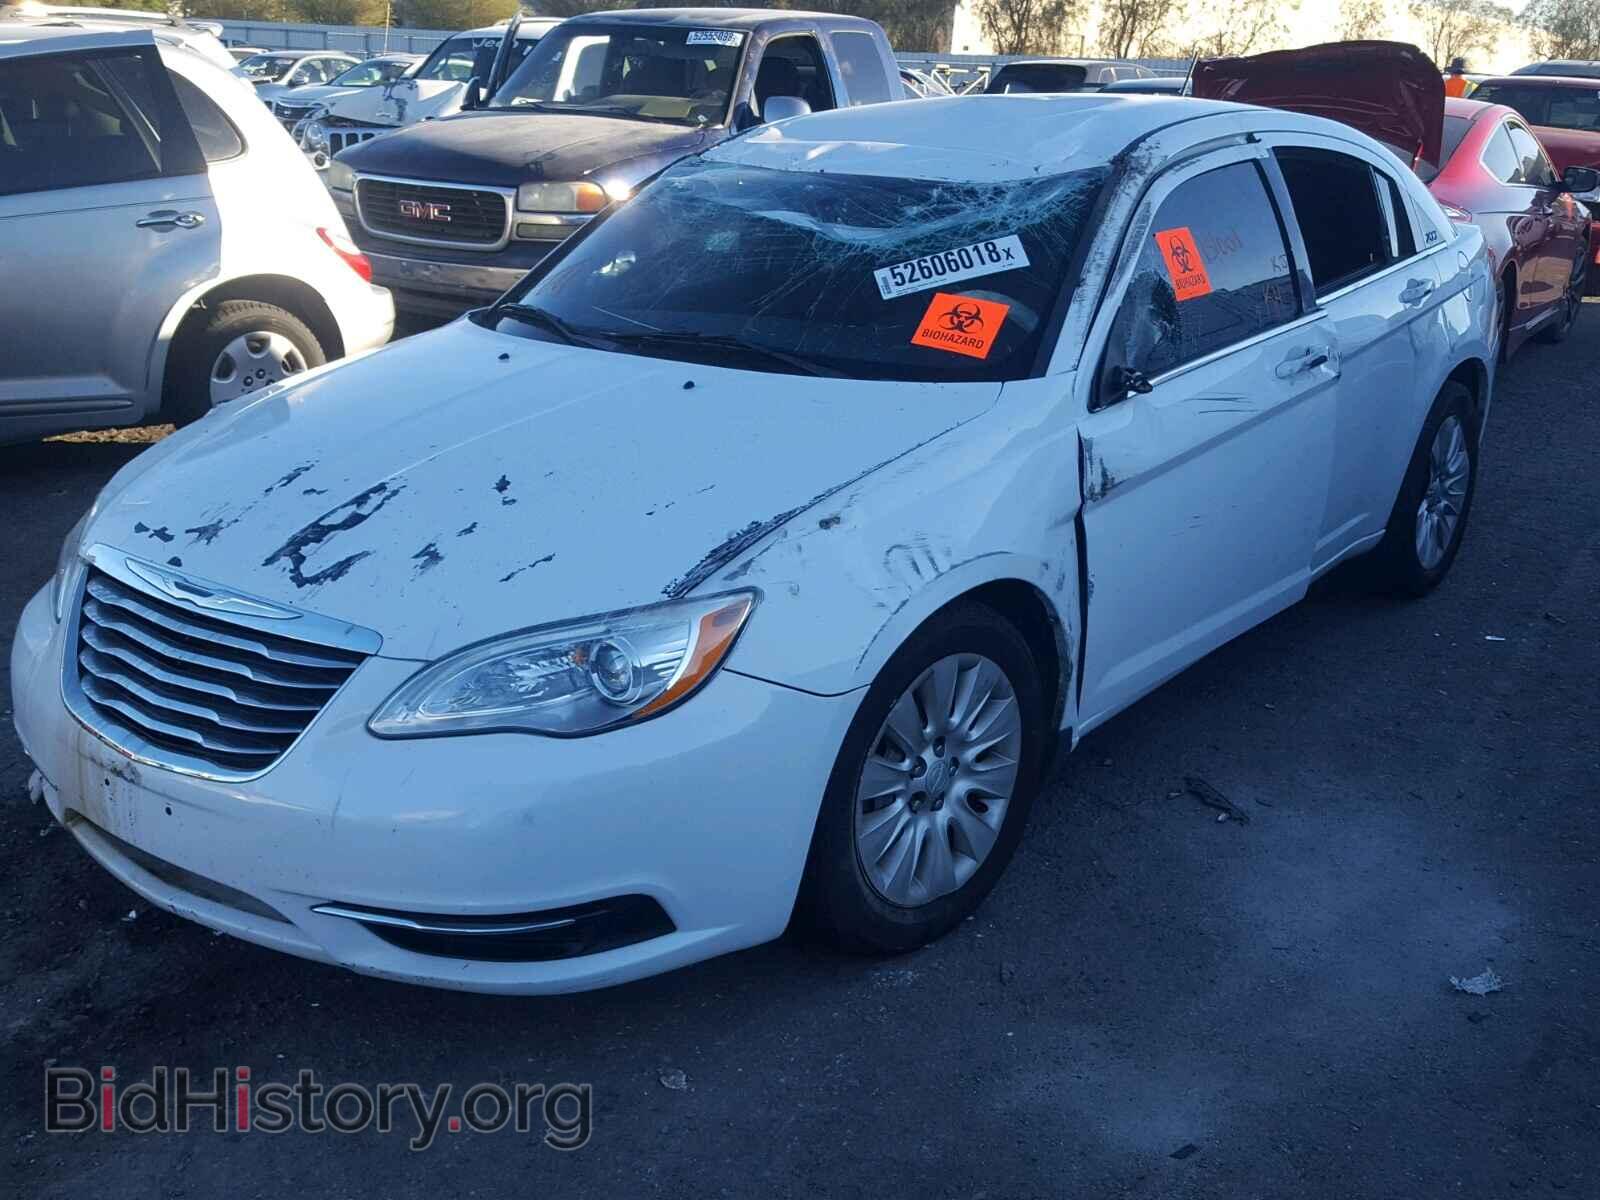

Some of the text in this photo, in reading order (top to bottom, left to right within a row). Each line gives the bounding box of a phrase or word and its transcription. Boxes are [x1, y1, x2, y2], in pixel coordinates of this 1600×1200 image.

[399, 199, 451, 223] GMC
[1175, 272, 1206, 290] BIOHAZARD
[921, 328, 985, 350] BIOHAZARD
